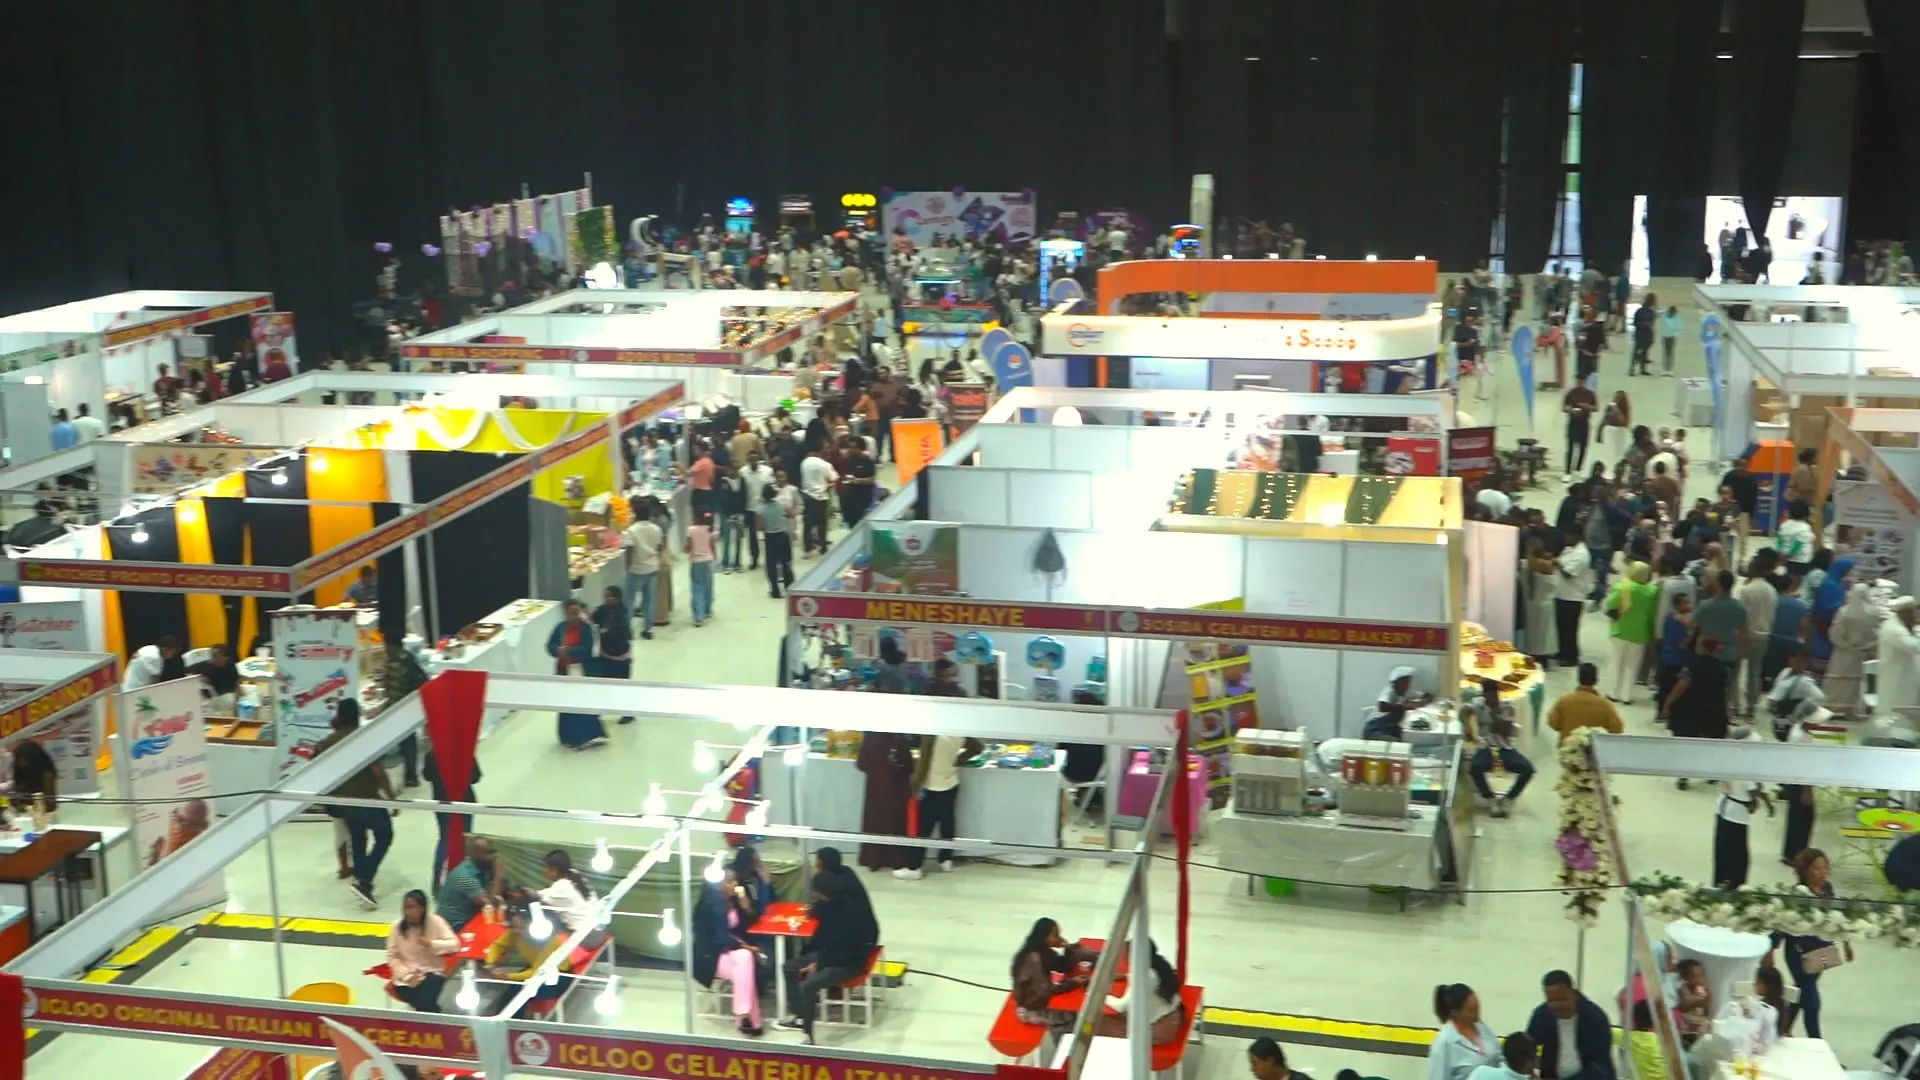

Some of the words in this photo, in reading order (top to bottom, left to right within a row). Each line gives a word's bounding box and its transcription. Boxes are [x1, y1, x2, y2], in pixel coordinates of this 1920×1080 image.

[174, 573, 265, 588] CHOCOLATE
[866, 600, 1025, 627] MENESHAYE
[1208, 622, 1297, 639] GELATERIA
[1304, 628, 1341, 641] AND
[1347, 629, 1414, 646] BAKERY
[41, 998, 109, 1019] IGLOO
[114, 1004, 220, 1029] ORIGINAL
[225, 1014, 313, 1038] ITALIAN
[558, 1042, 654, 1071] IGLOO
